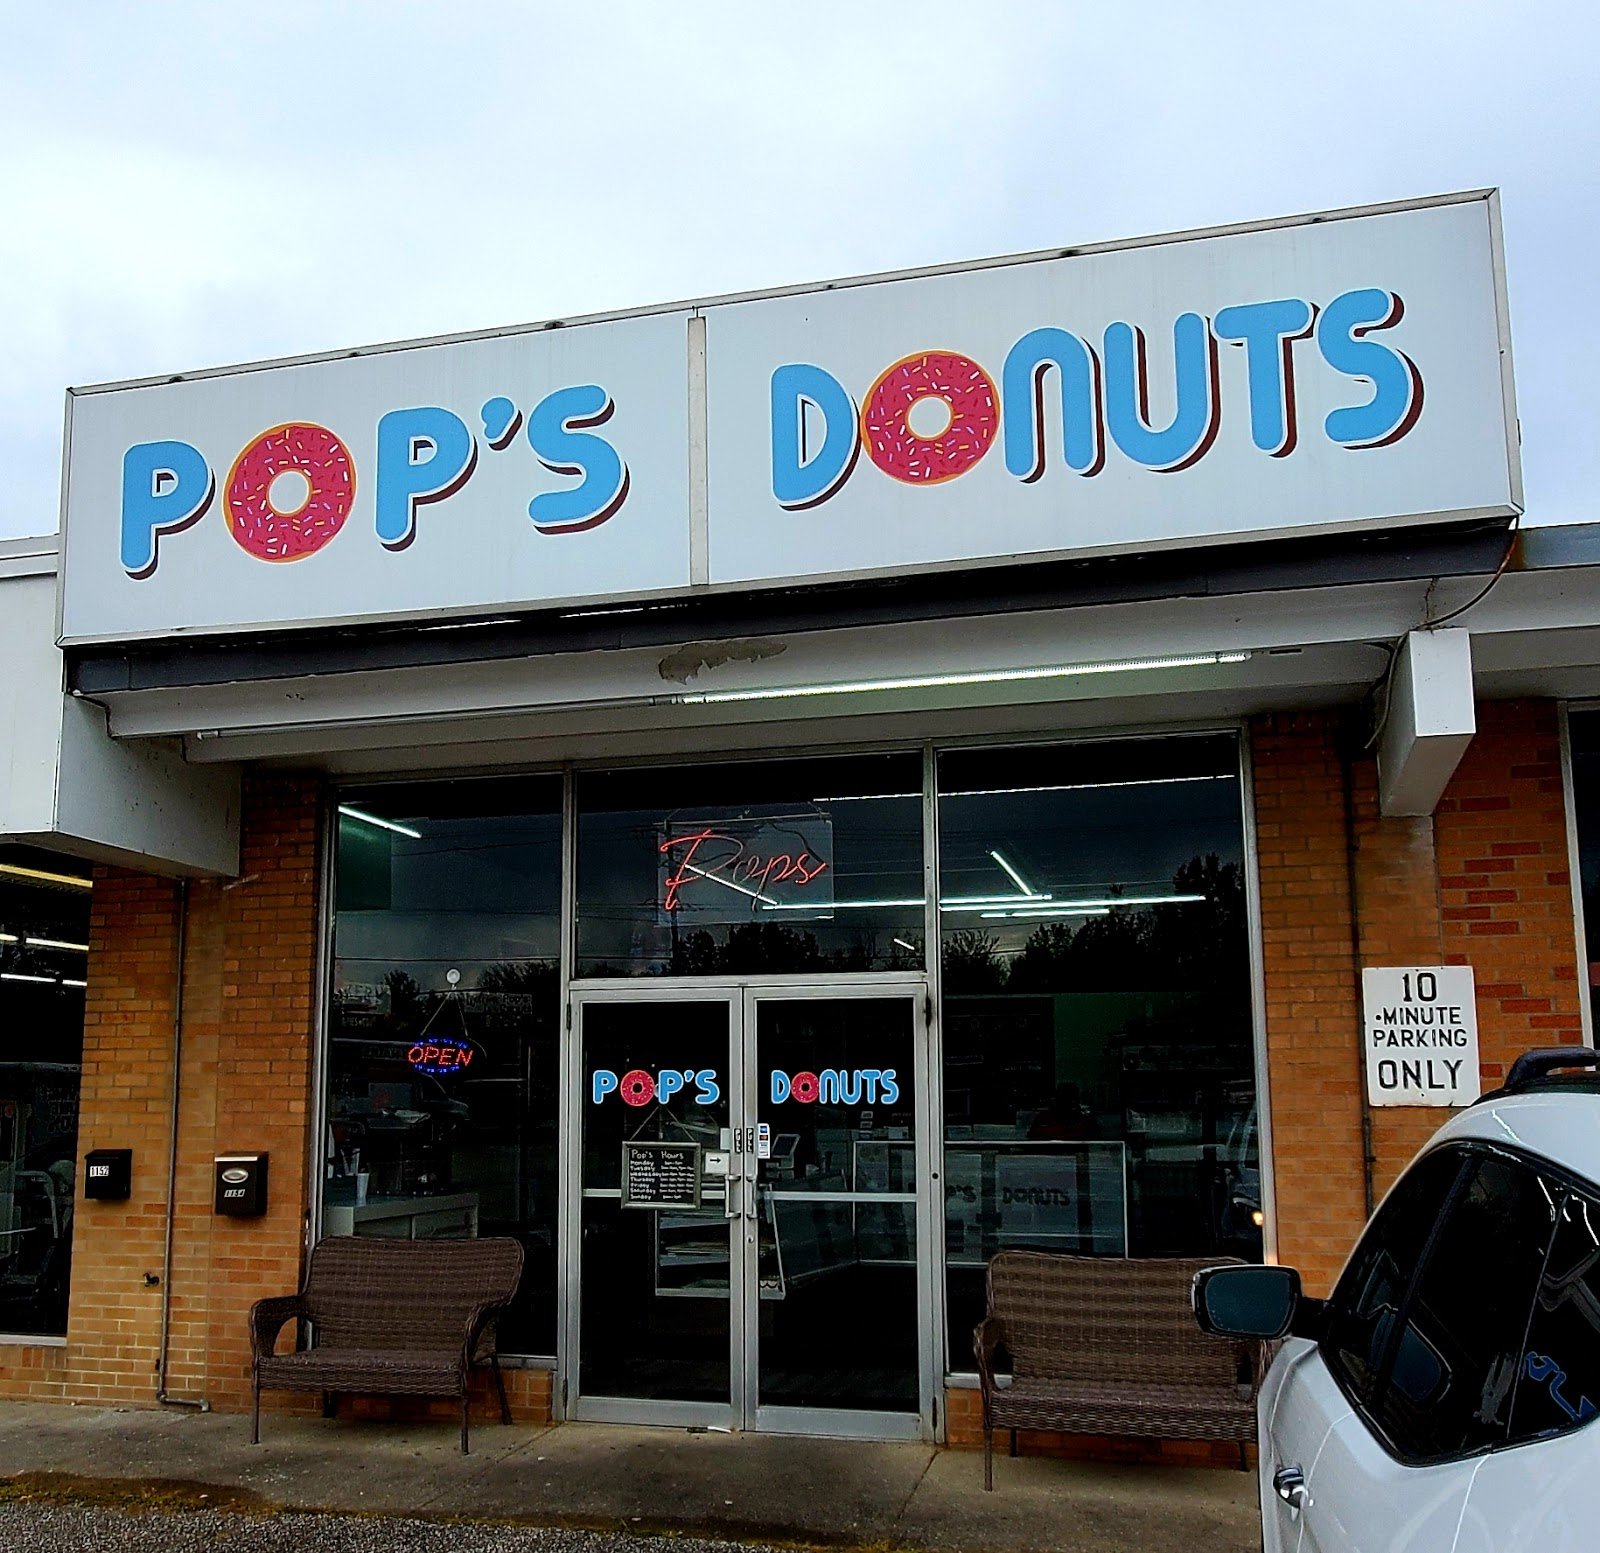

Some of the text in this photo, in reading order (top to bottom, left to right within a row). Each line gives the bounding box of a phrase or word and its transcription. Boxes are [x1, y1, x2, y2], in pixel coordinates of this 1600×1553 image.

[121, 287, 1425, 580] POP'S DONUTS
[1402, 972, 1437, 1002] 10
[1383, 1007, 1462, 1025] MINUTE
[1373, 1029, 1468, 1047] PARKING
[408, 1046, 474, 1067] OPEN
[1378, 1060, 1463, 1090] ONLY
[593, 1069, 899, 1107] POP'S DONUTS
[631, 1149, 684, 1160] Pop's Hours
[91, 1166, 109, 1176] 1152
